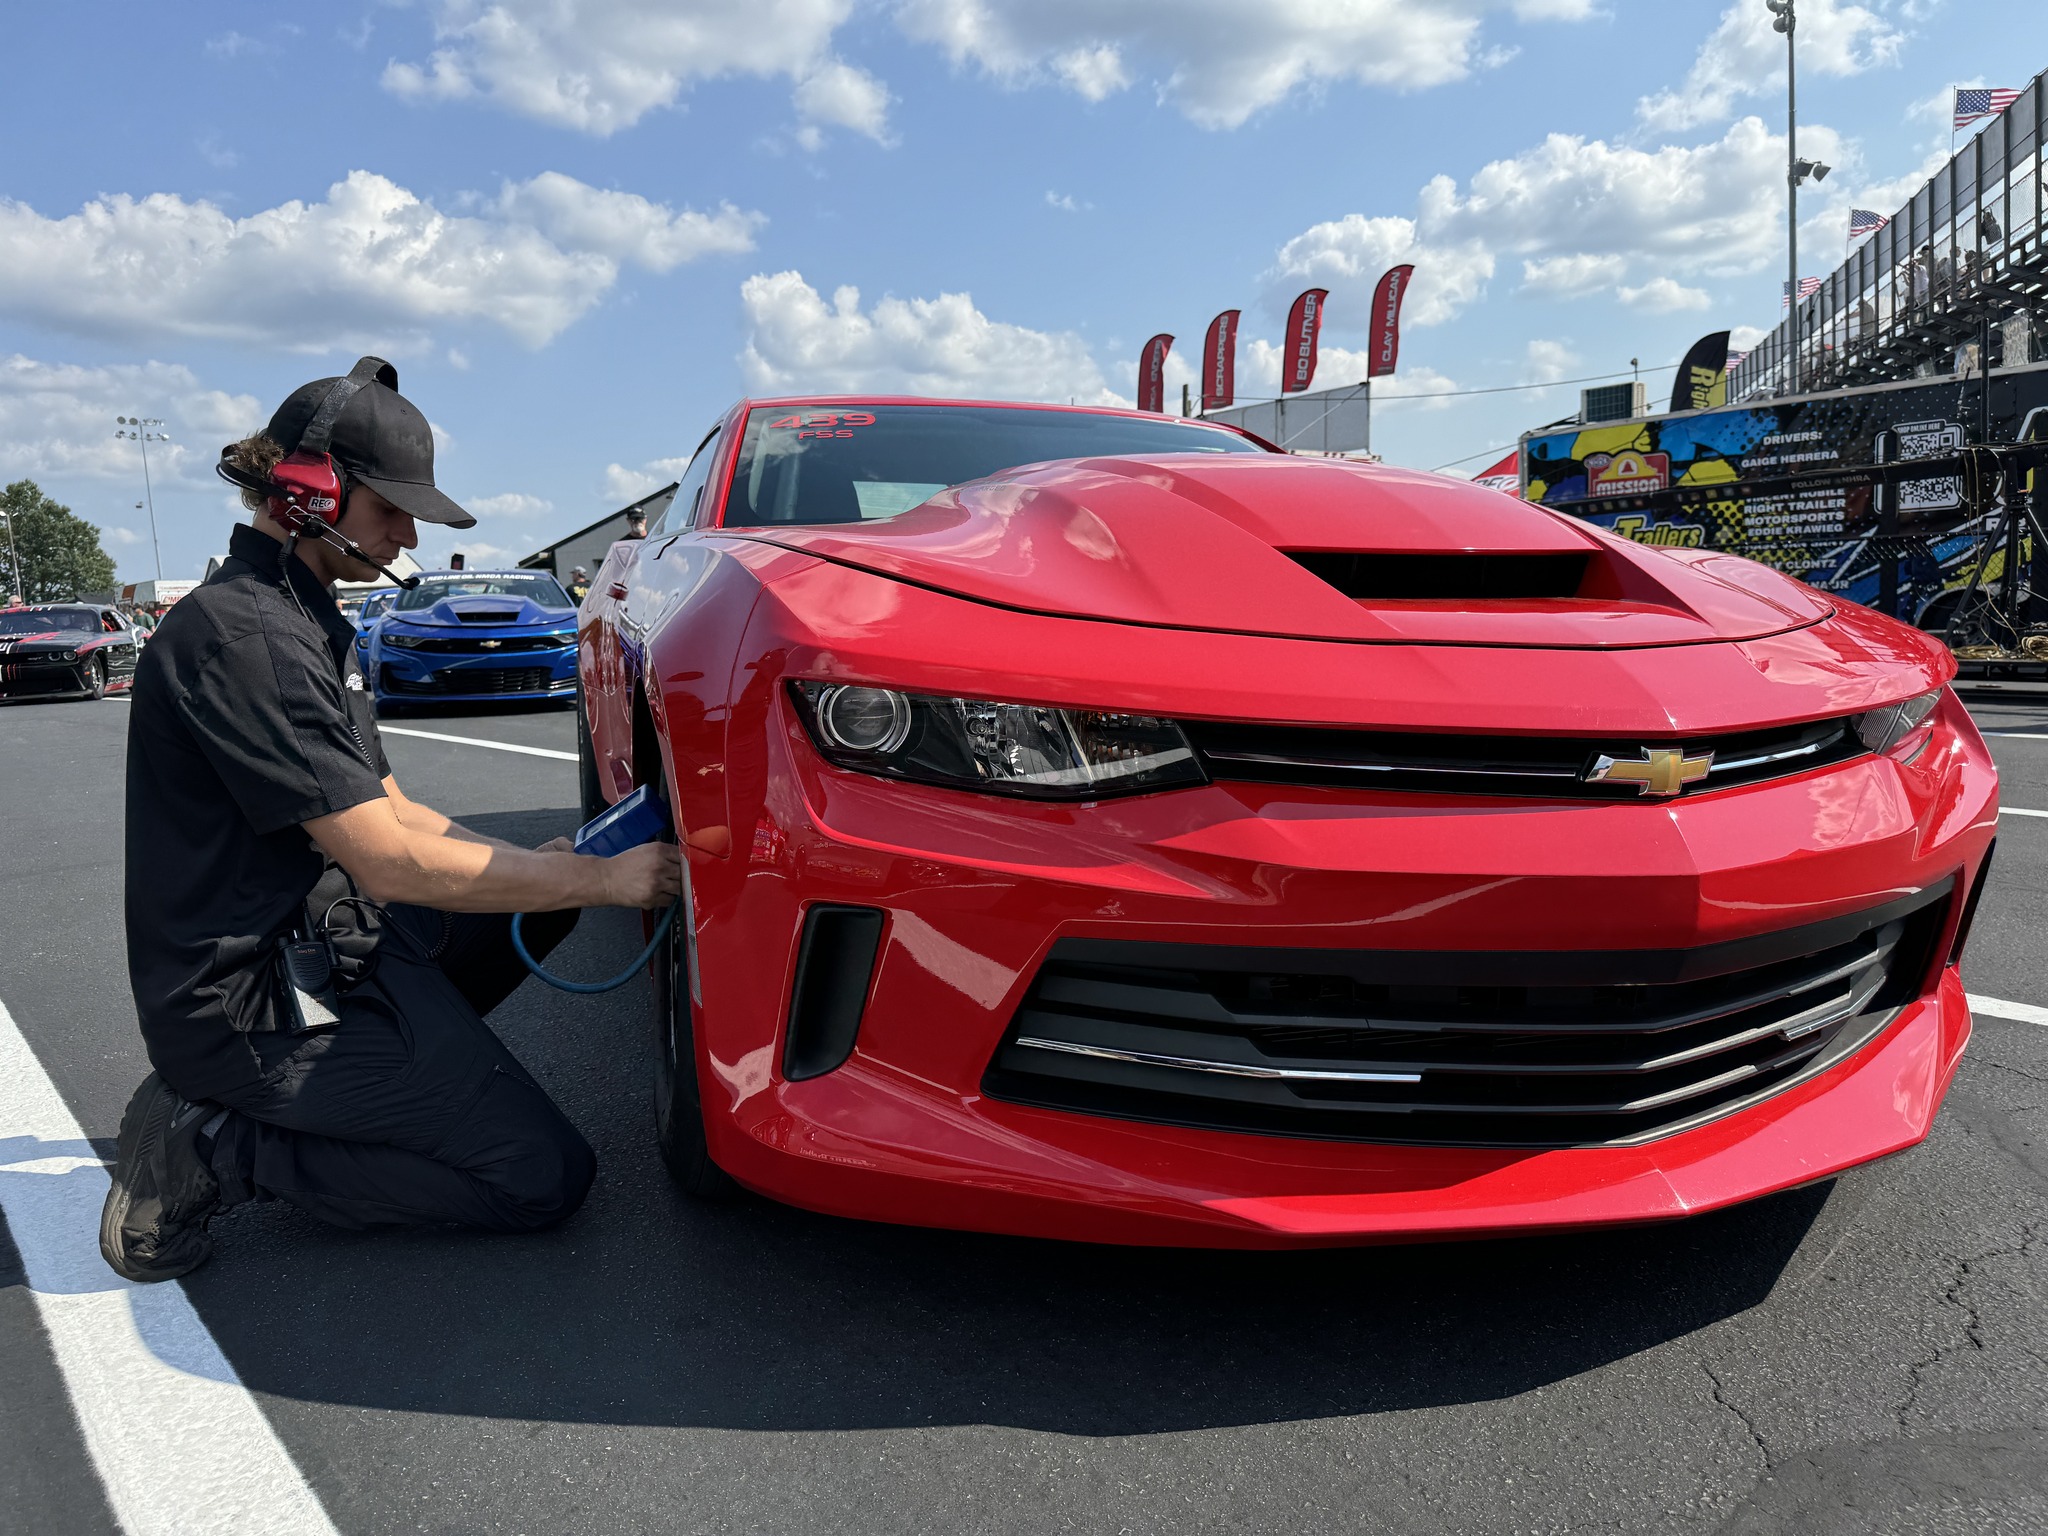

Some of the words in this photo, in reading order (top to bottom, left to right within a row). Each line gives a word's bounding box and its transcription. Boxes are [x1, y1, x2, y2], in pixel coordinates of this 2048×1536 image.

[1385, 271, 1401, 327] MILLICAN
[1299, 293, 1317, 357] BUTNER
[1382, 331, 1393, 362] CLAY
[1215, 315, 1229, 397] SCRAPPERS
[1296, 358, 1309, 380] BO
[1690, 365, 1717, 409] Righ
[769, 413, 876, 429] 439
[1910, 423, 1928, 433] ONLINE
[1927, 421, 1941, 431] HERE
[798, 429, 854, 440] FSS
[1763, 431, 1823, 446] DRIVERS:
[1741, 456, 1778, 468] GAIGE
[1780, 450, 1839, 464] HERRERA
[1791, 479, 1831, 489] FOLLOW
[1743, 503, 1785, 514] RIGHT
[1788, 498, 1846, 511] TRAILER
[1744, 511, 1845, 526] MOTORSPORTS
[1747, 526, 1783, 537] EDDIE
[1785, 523, 1844, 535] KRAWIEG
[1785, 559, 1837, 570] CLONTZ
